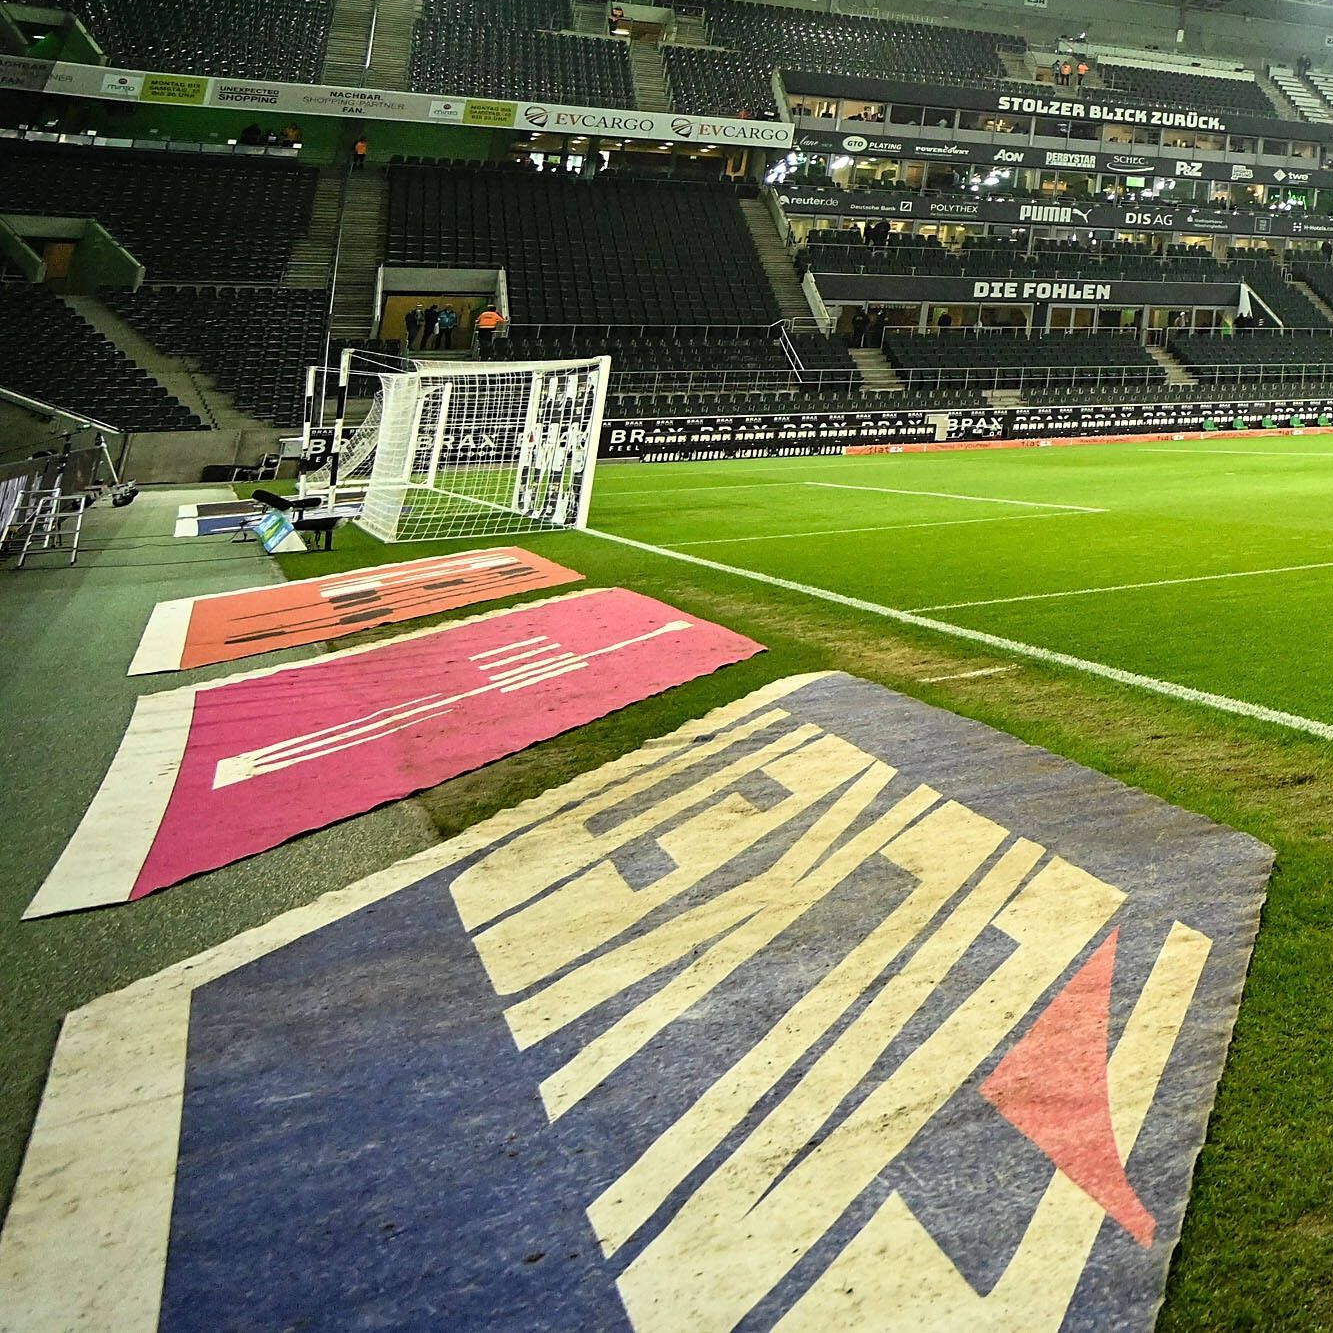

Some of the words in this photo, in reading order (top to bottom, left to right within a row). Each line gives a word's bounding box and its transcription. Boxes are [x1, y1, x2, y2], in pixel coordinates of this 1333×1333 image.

[219, 85, 280, 95] UNEXPECTED
[218, 94, 278, 104] SHOPPING
[329, 91, 384, 101] NACHBAR.
[342, 106, 366, 115] FAN.
[998, 96, 1085, 117] STOLZER
[1089, 105, 1147, 123] BLICK
[1151, 111, 1226, 131] ZURÜCK.
[869, 142, 902, 151] PLATING
[1046, 151, 1096, 164] DERBYSTAR
[1176, 161, 1203, 177] P&Z
[1288, 171, 1309, 182] twe
[790, 196, 839, 207] reuter.de
[850, 203, 879, 211] Deutsche
[930, 203, 978, 213] POLYTHEX
[1020, 205, 1073, 223] PUMA
[1125, 212, 1151, 225] DIS
[1153, 214, 1173, 226] AG
[973, 281, 1018, 298] DIE
[1022, 282, 1111, 300] FOHLEN
[948, 418, 1004, 433] BRAX
